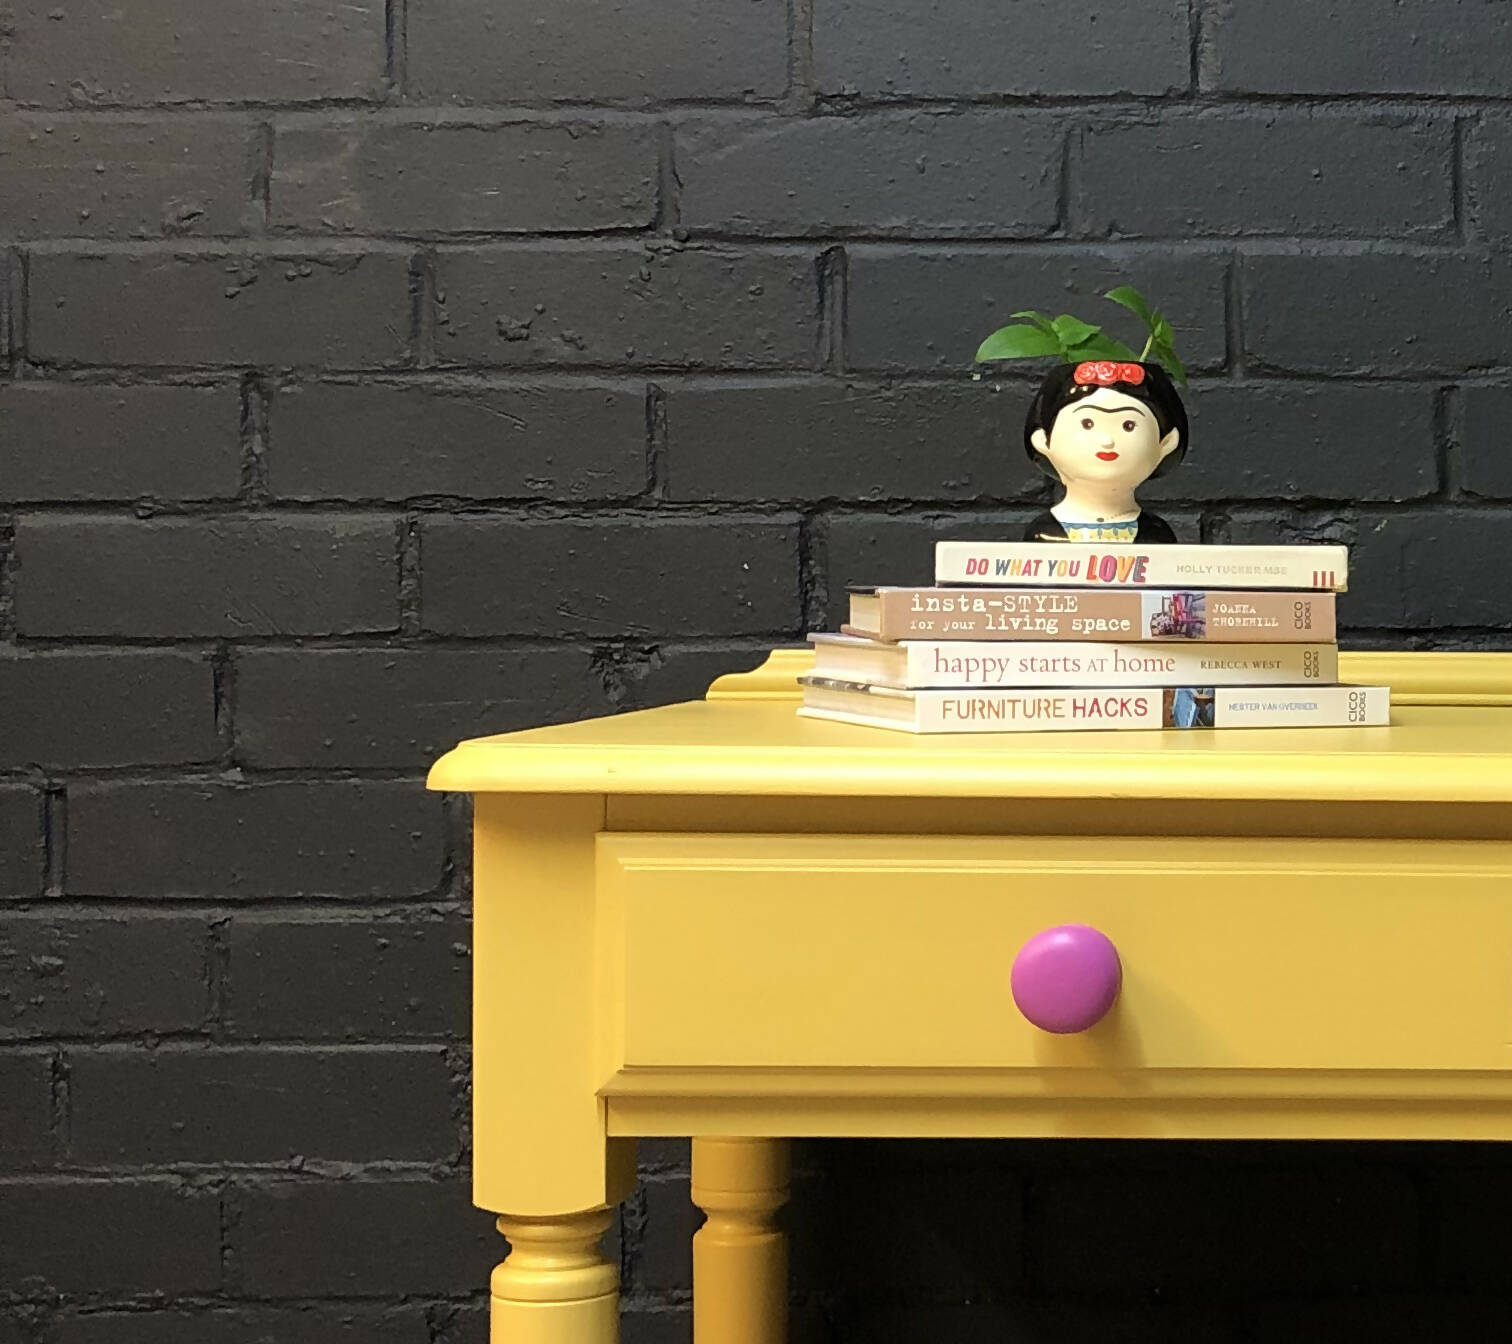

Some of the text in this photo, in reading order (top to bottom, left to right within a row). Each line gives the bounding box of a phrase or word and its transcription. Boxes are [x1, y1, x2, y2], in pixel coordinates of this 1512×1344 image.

[966, 554, 1150, 583] DO WHAT YOU LOVE
[1176, 564, 1213, 574] HOLLY
[910, 593, 1079, 613] insta-STYLE
[1294, 601, 1303, 630] CICO
[909, 613, 1131, 635] for your living space
[933, 648, 1176, 683] happy starts AT home
[1200, 660, 1282, 670] REBECCA WEST
[1303, 650, 1312, 678] CICO
[942, 697, 1149, 721] FURNITURE HACKS
[1348, 691, 1358, 722] CICO
